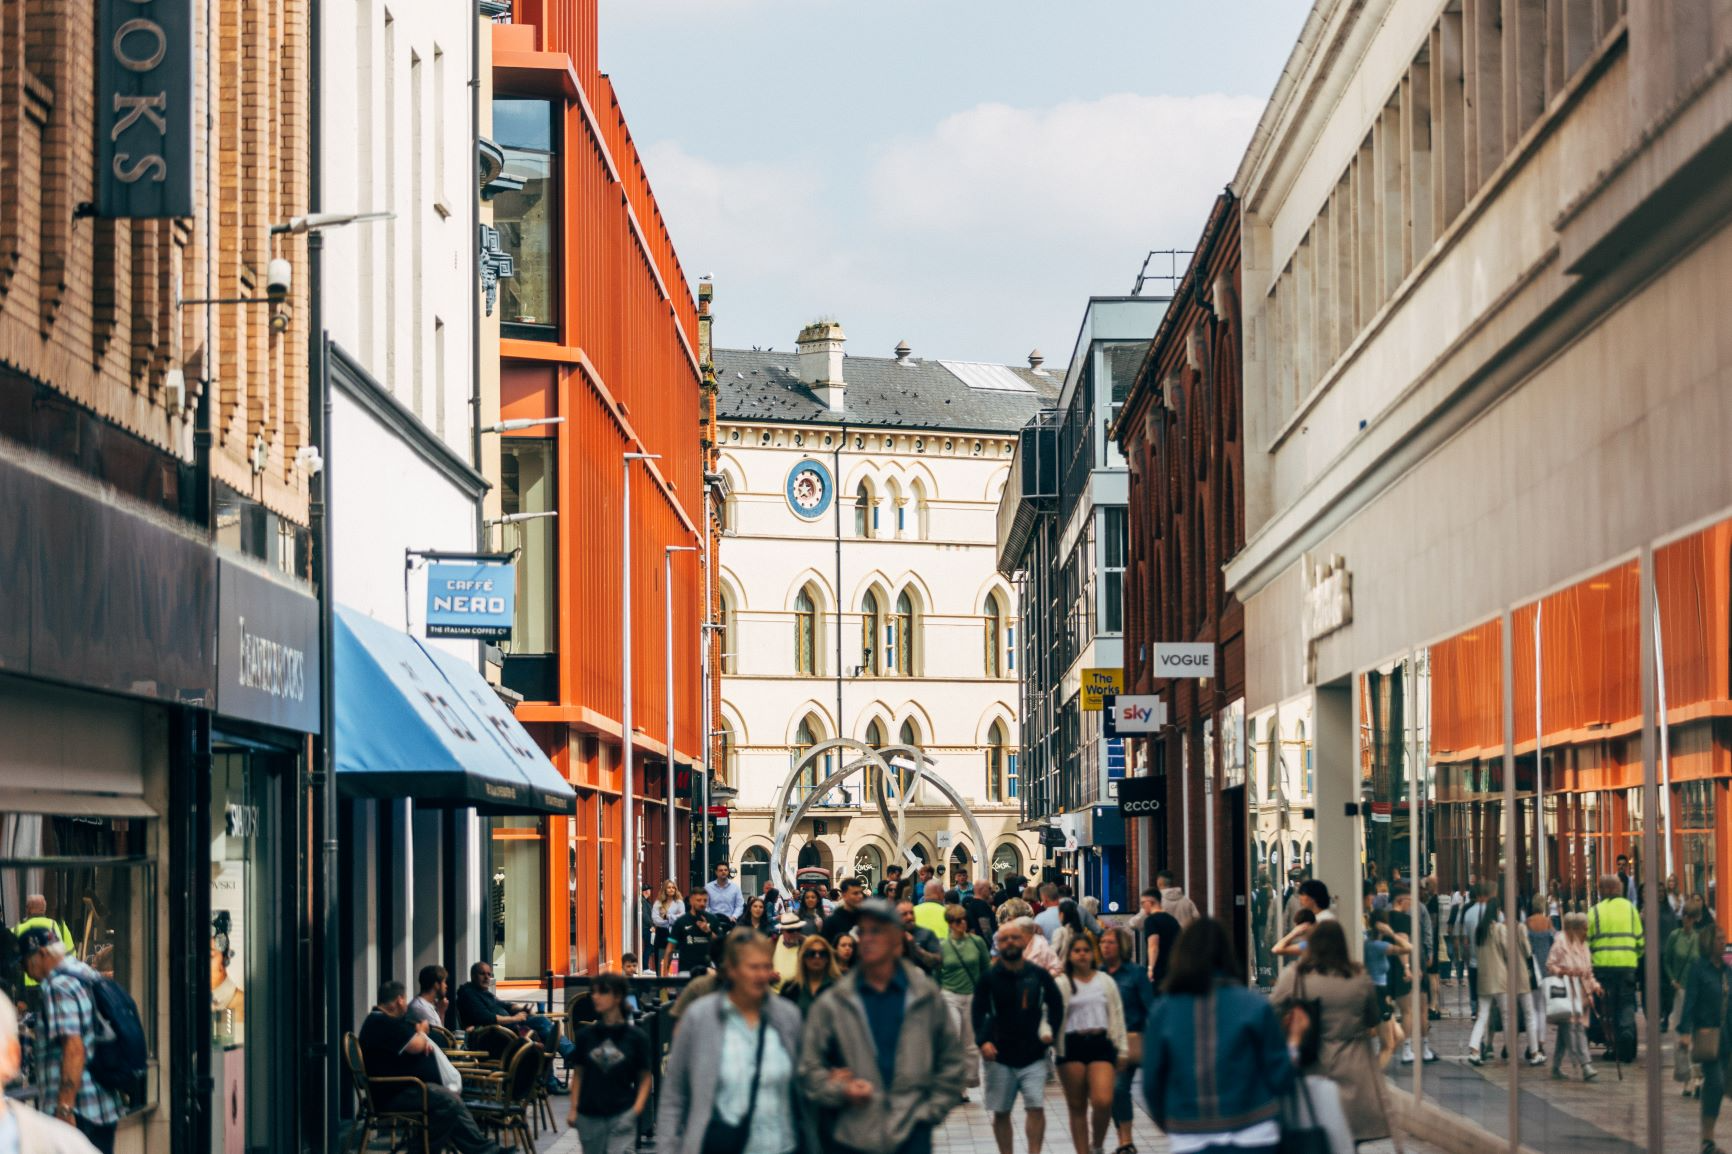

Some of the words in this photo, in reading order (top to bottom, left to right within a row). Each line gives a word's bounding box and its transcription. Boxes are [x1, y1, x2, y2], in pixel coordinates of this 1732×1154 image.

[112, 0, 167, 182] OKS
[434, 596, 505, 613] NERO
[444, 626, 470, 634] ITALIAN
[1161, 654, 1209, 666] VOGUE
[1092, 673, 1112, 683] The
[1086, 685, 1120, 695] Works
[1123, 704, 1152, 723] sky
[1124, 800, 1160, 811] ecco
